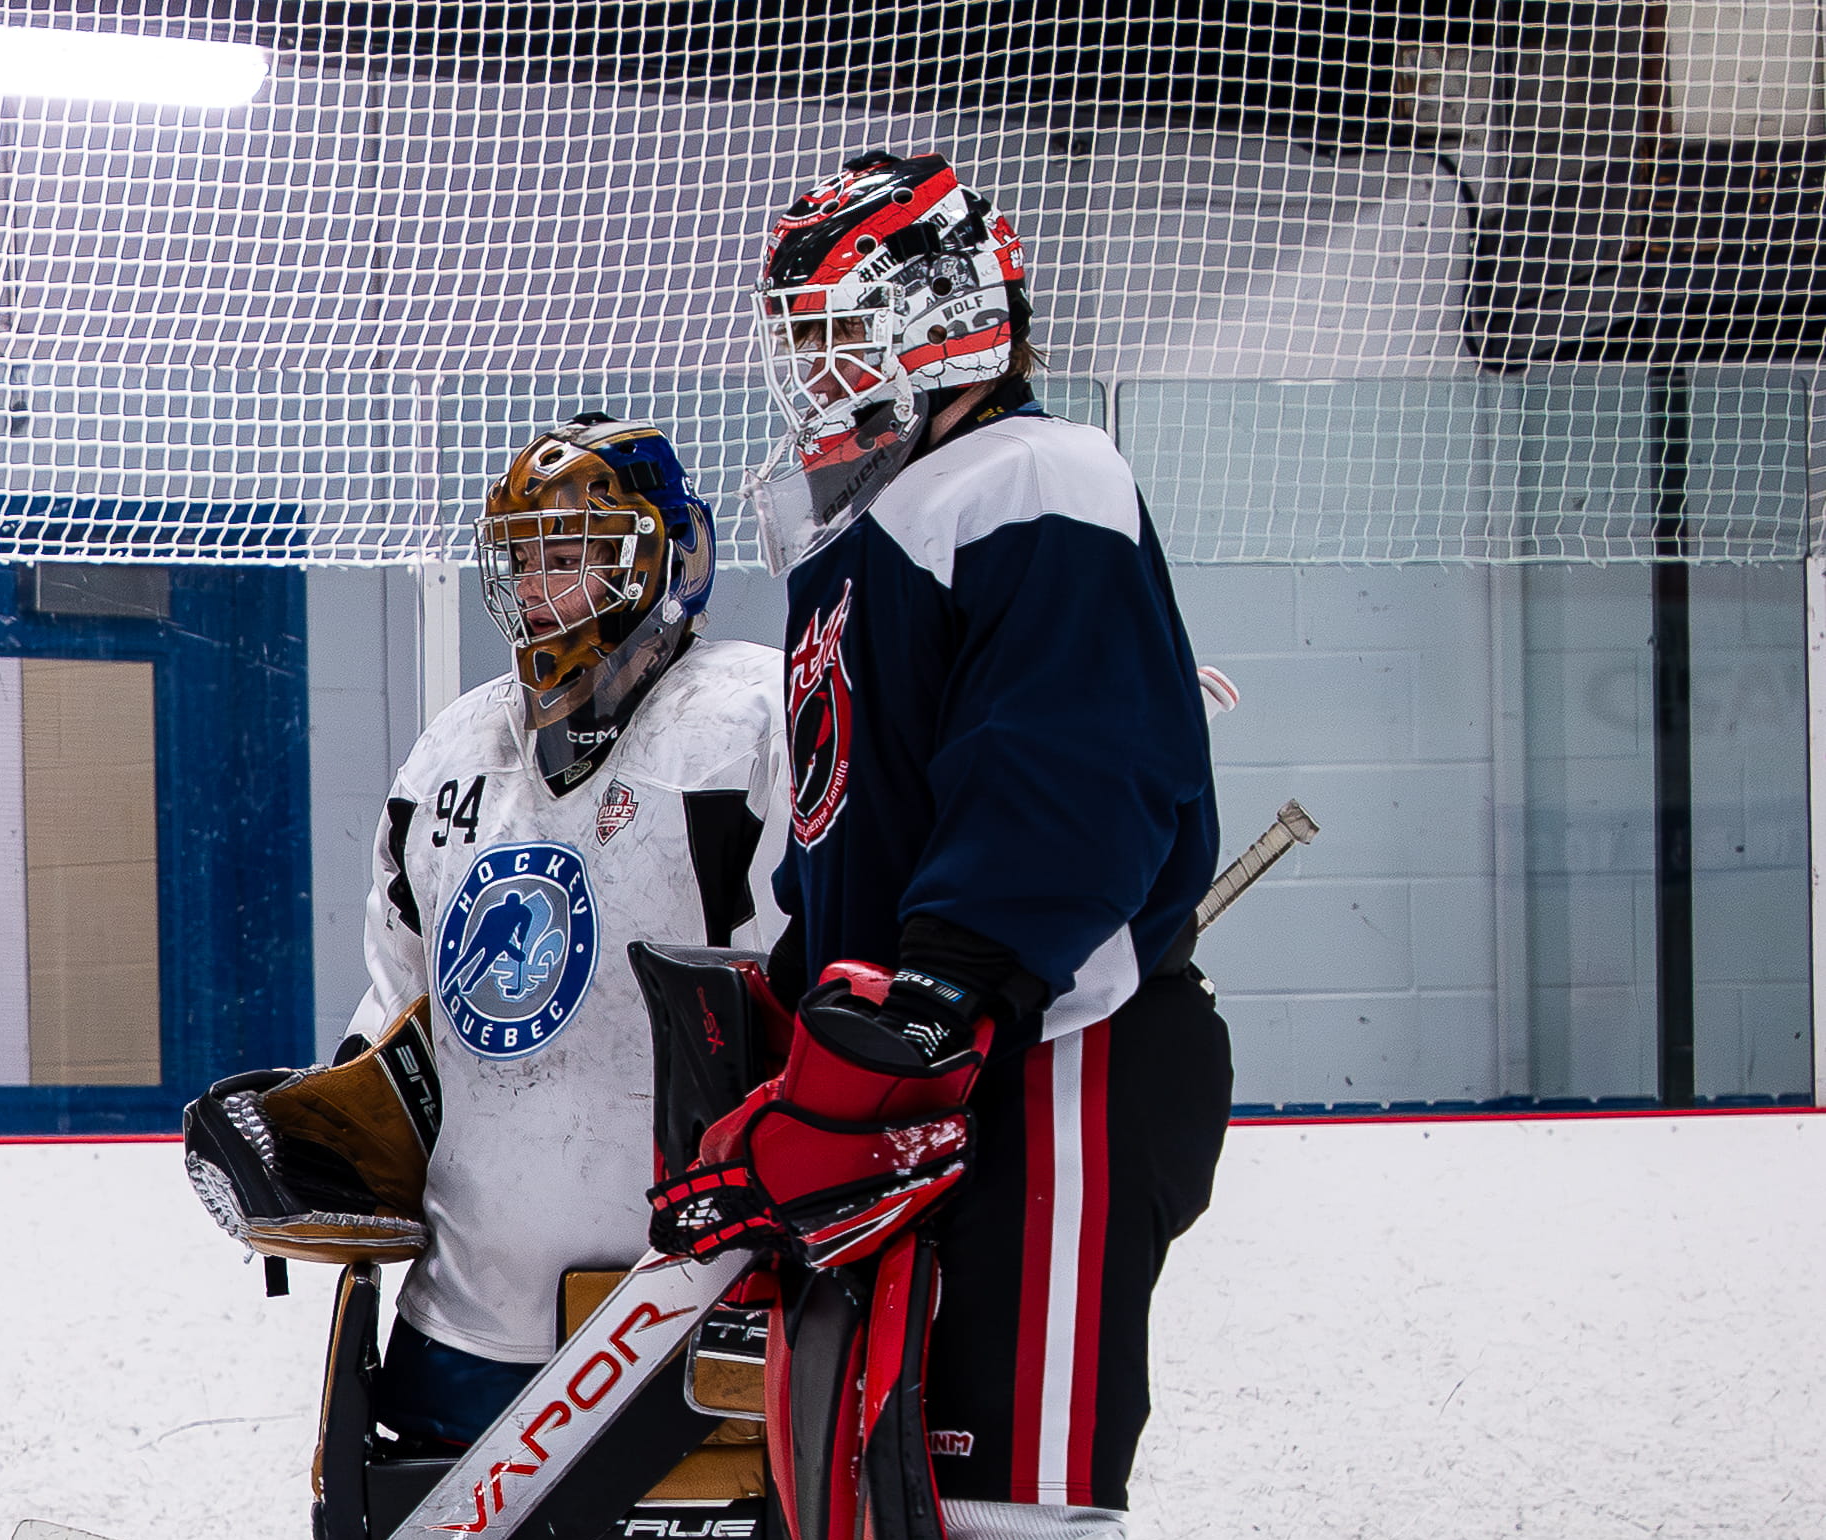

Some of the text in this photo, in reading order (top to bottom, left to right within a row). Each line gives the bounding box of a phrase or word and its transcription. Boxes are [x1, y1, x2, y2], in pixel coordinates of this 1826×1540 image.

[942, 295, 984, 321] WOLF
[432, 775, 487, 848] 94
[458, 852, 588, 916] HOCKEY
[449, 995, 564, 1047] QUÉBEC
[425, 1302, 698, 1533] VAPOR
[616, 1519, 756, 1537] RUE
